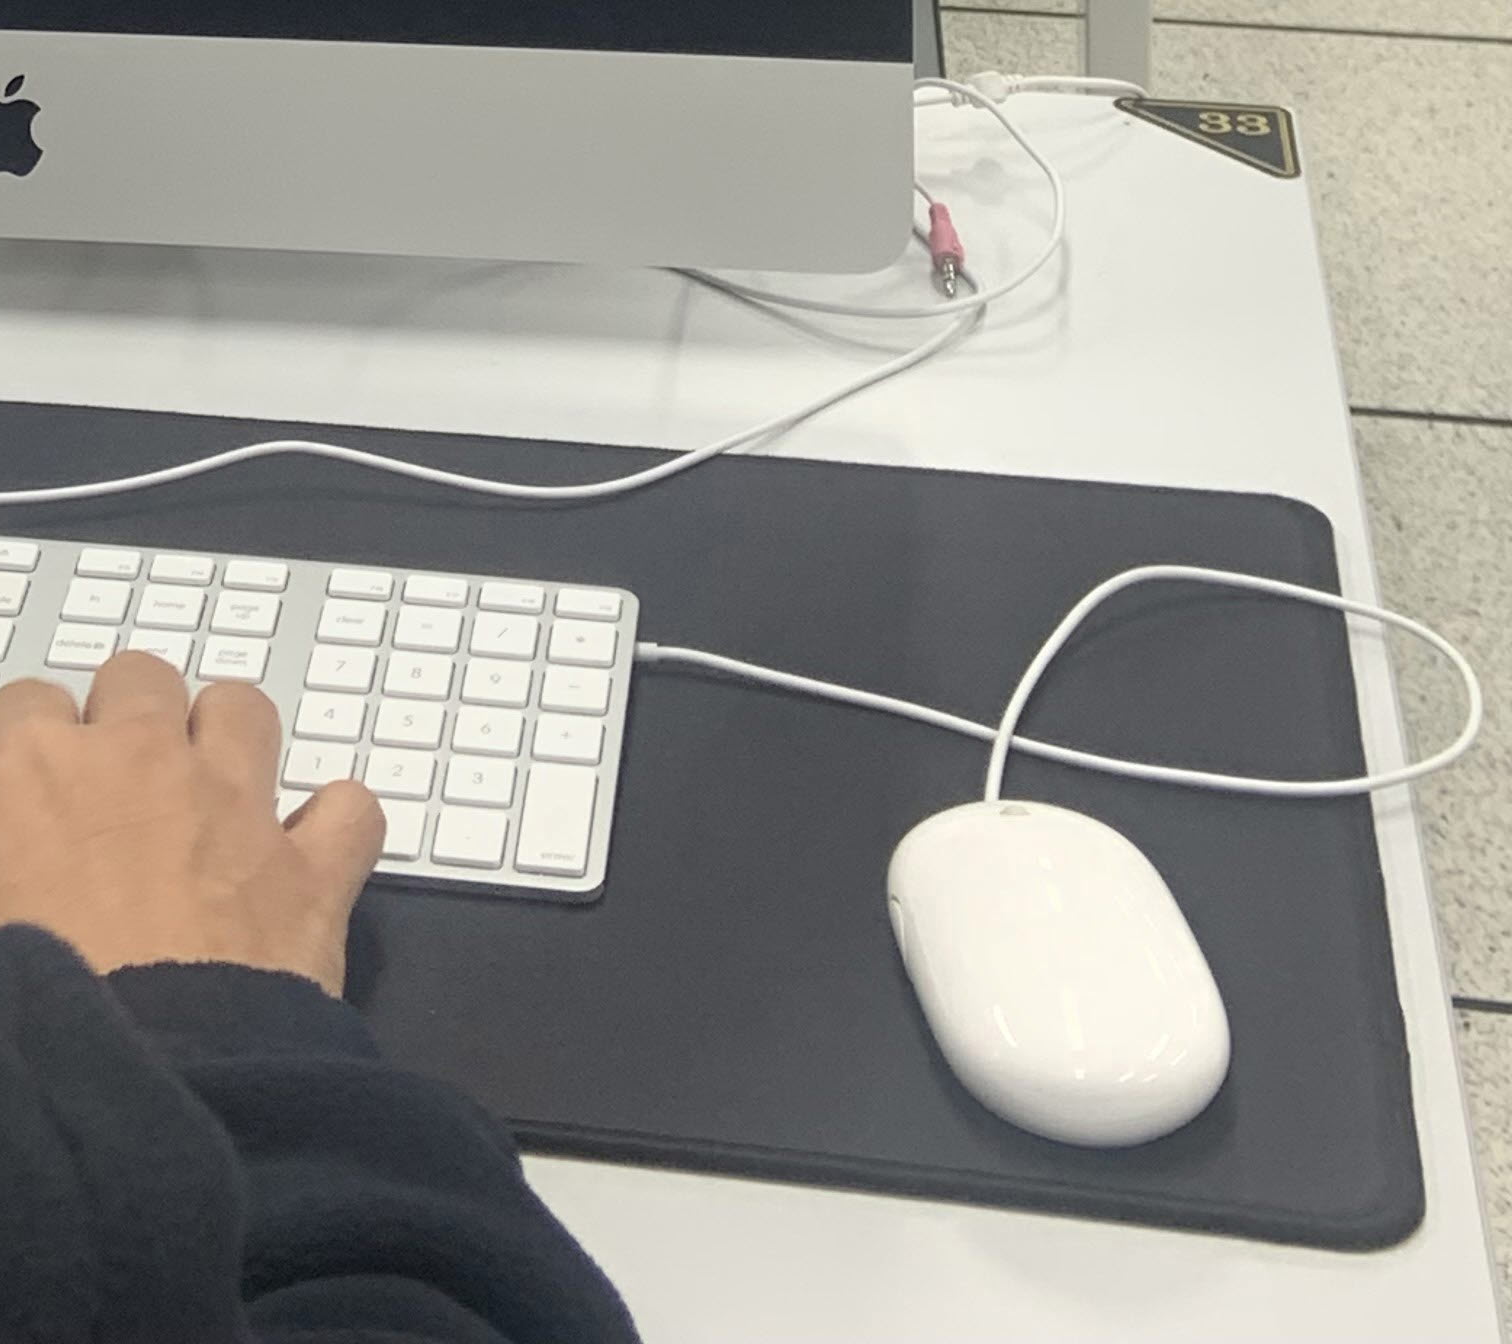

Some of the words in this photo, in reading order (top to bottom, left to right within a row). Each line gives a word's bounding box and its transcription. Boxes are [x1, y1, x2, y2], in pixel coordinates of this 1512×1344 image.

[335, 660, 347, 673] 7
[410, 666, 423, 680] 8
[489, 672, 502, 686] 9
[323, 707, 335, 720] 4
[402, 714, 414, 728] 5
[479, 721, 492, 735] 6
[391, 764, 404, 777] 2
[472, 771, 484, 785] 3
